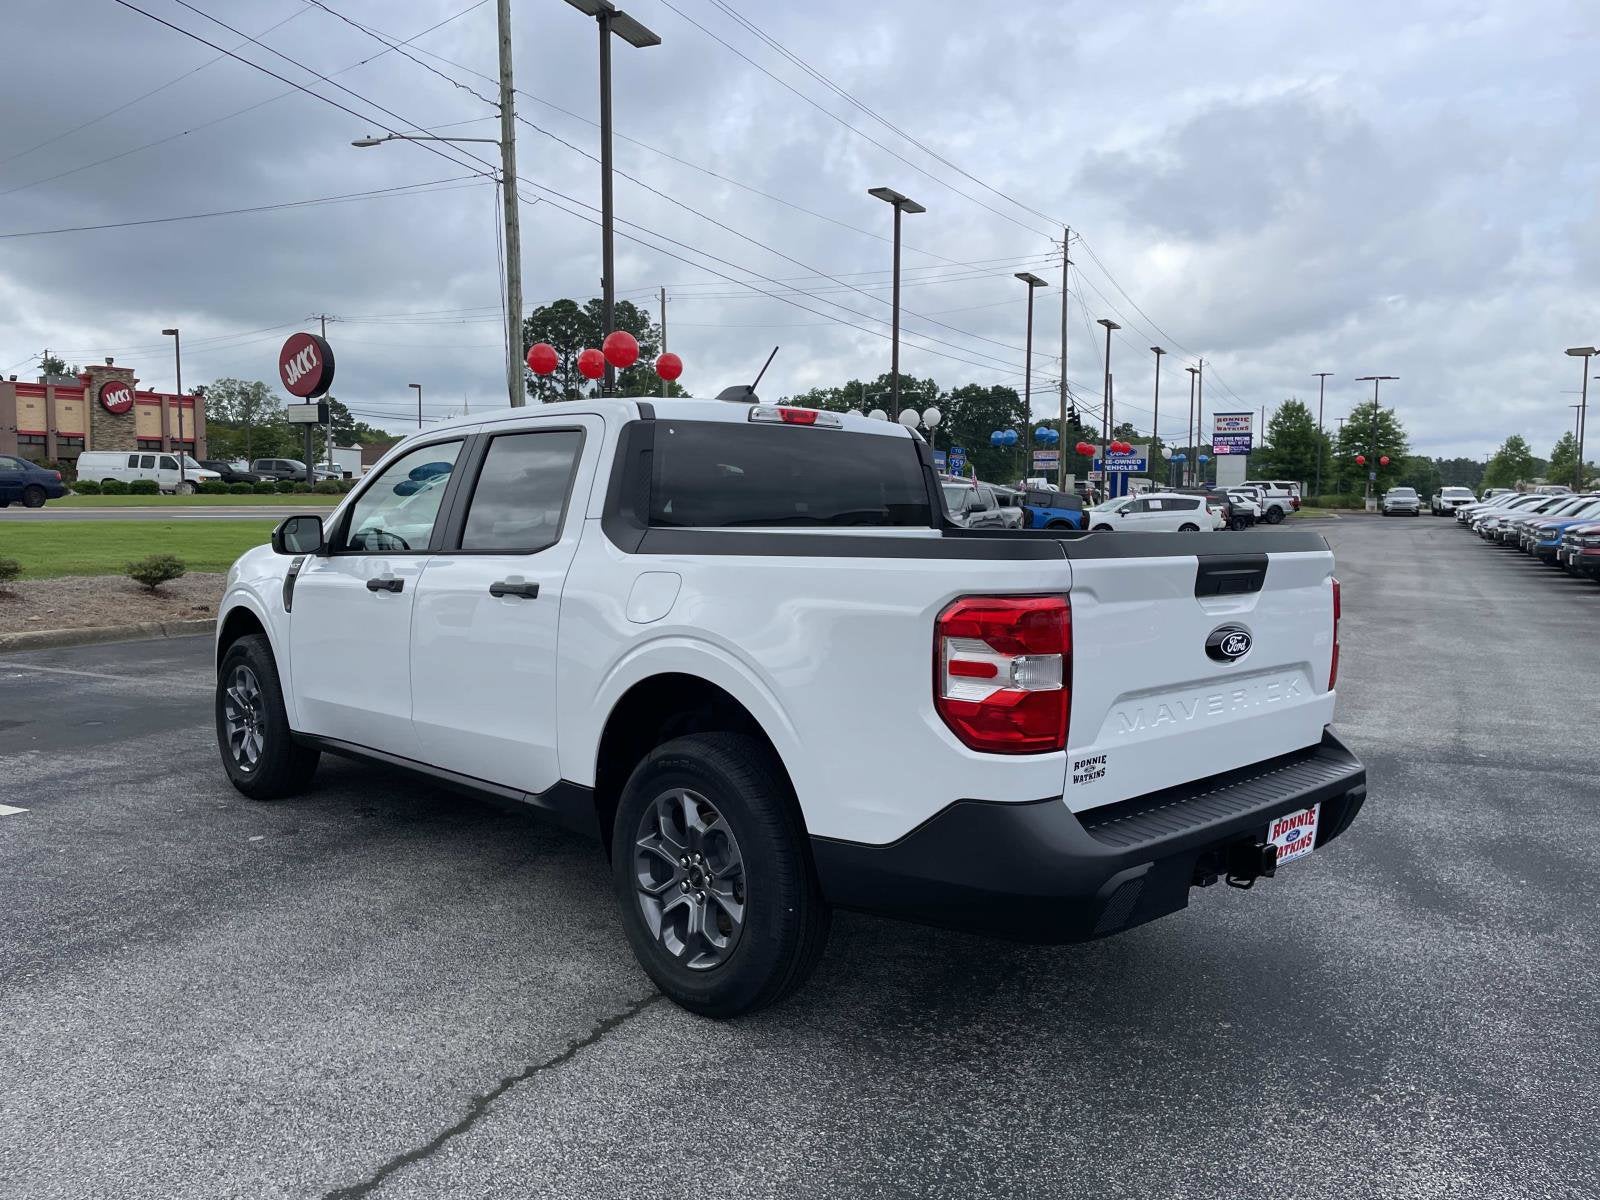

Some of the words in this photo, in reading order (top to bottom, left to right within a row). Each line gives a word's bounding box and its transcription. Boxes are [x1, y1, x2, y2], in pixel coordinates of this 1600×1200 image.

[951, 459, 964, 467] 759
[1227, 636, 1246, 652] Ford
[1117, 679, 1300, 735] MAVERICK
[1074, 754, 1107, 771] RONNIE
[1073, 767, 1106, 784] WATKINS
[1272, 809, 1316, 841] RONNIE
[1276, 831, 1313, 858] ATKINS
